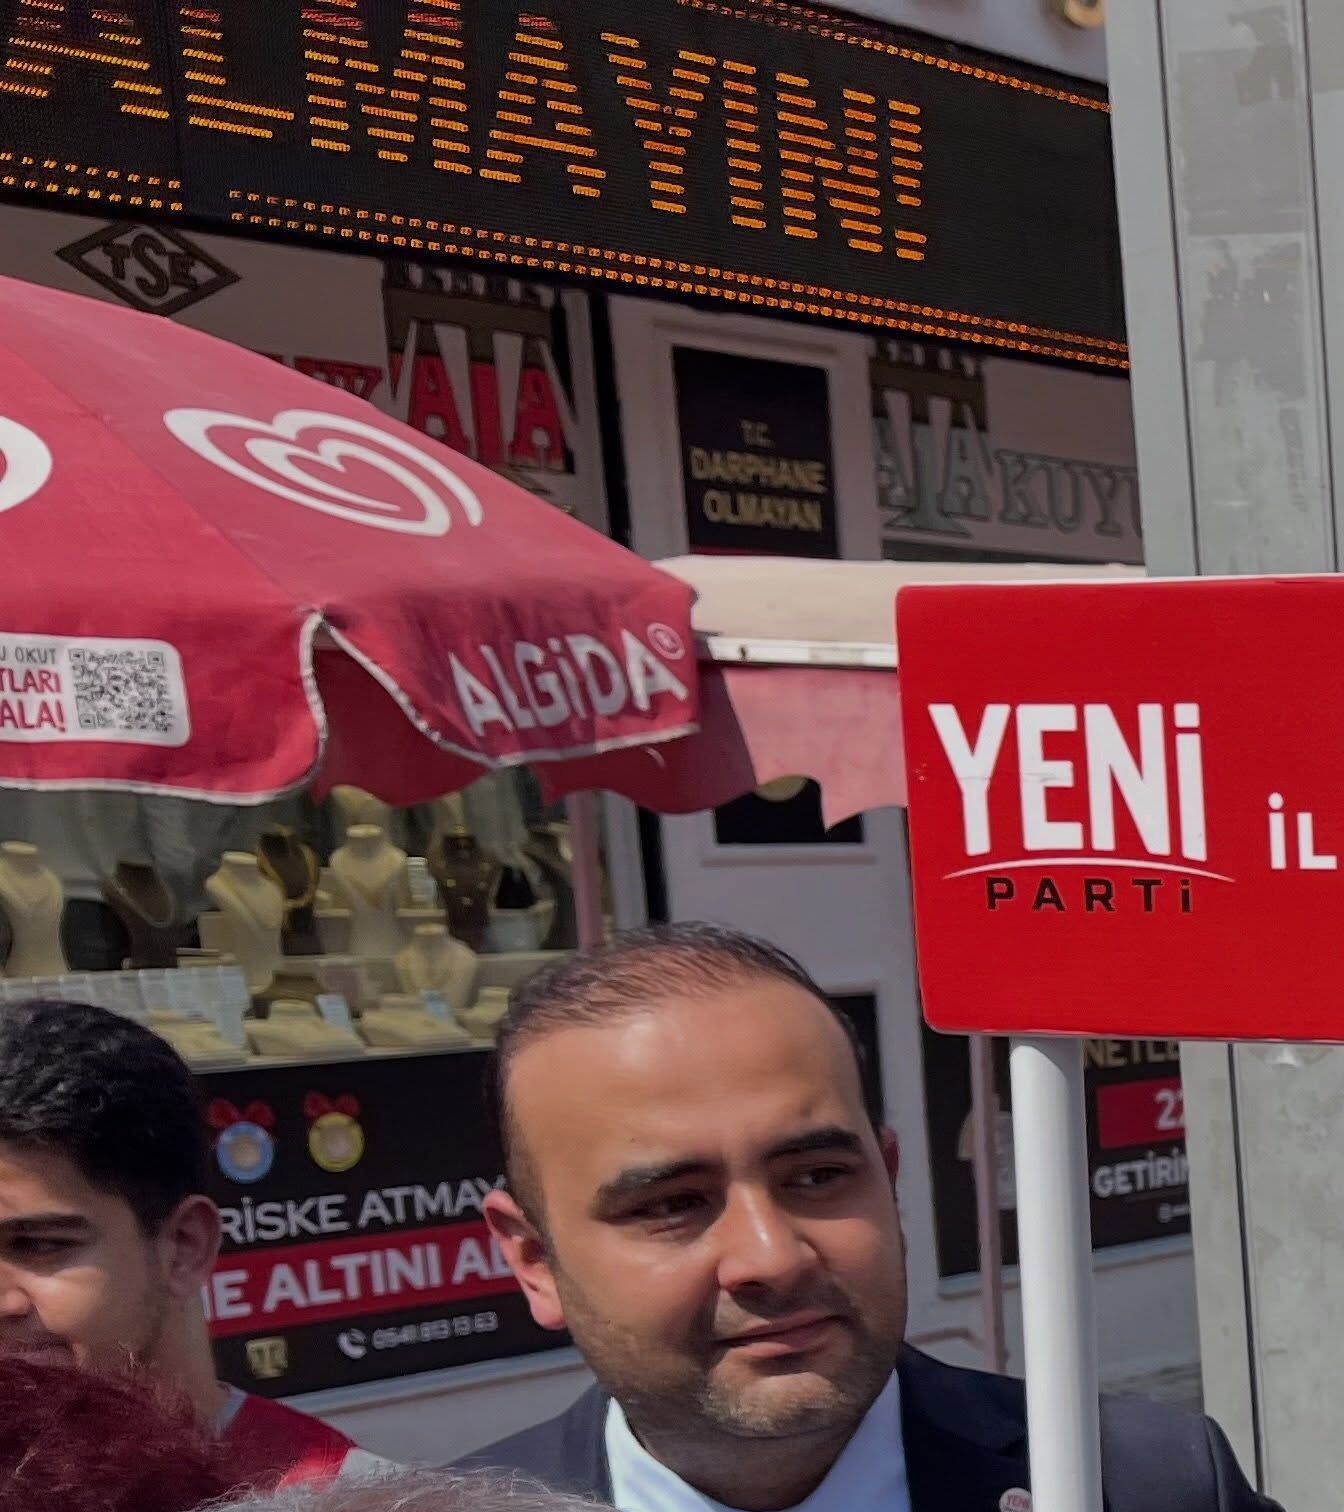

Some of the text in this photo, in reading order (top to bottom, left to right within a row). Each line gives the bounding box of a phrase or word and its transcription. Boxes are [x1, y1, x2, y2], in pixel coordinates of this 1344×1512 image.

[101, 233, 202, 297] TSE
[690, 446, 826, 493] DARPHANE
[703, 492, 822, 532] OLMAYAN
[15, 647, 56, 665] OKUT
[1268, 792, 1338, 871] İL
[262, 1243, 442, 1312] ALTINI
